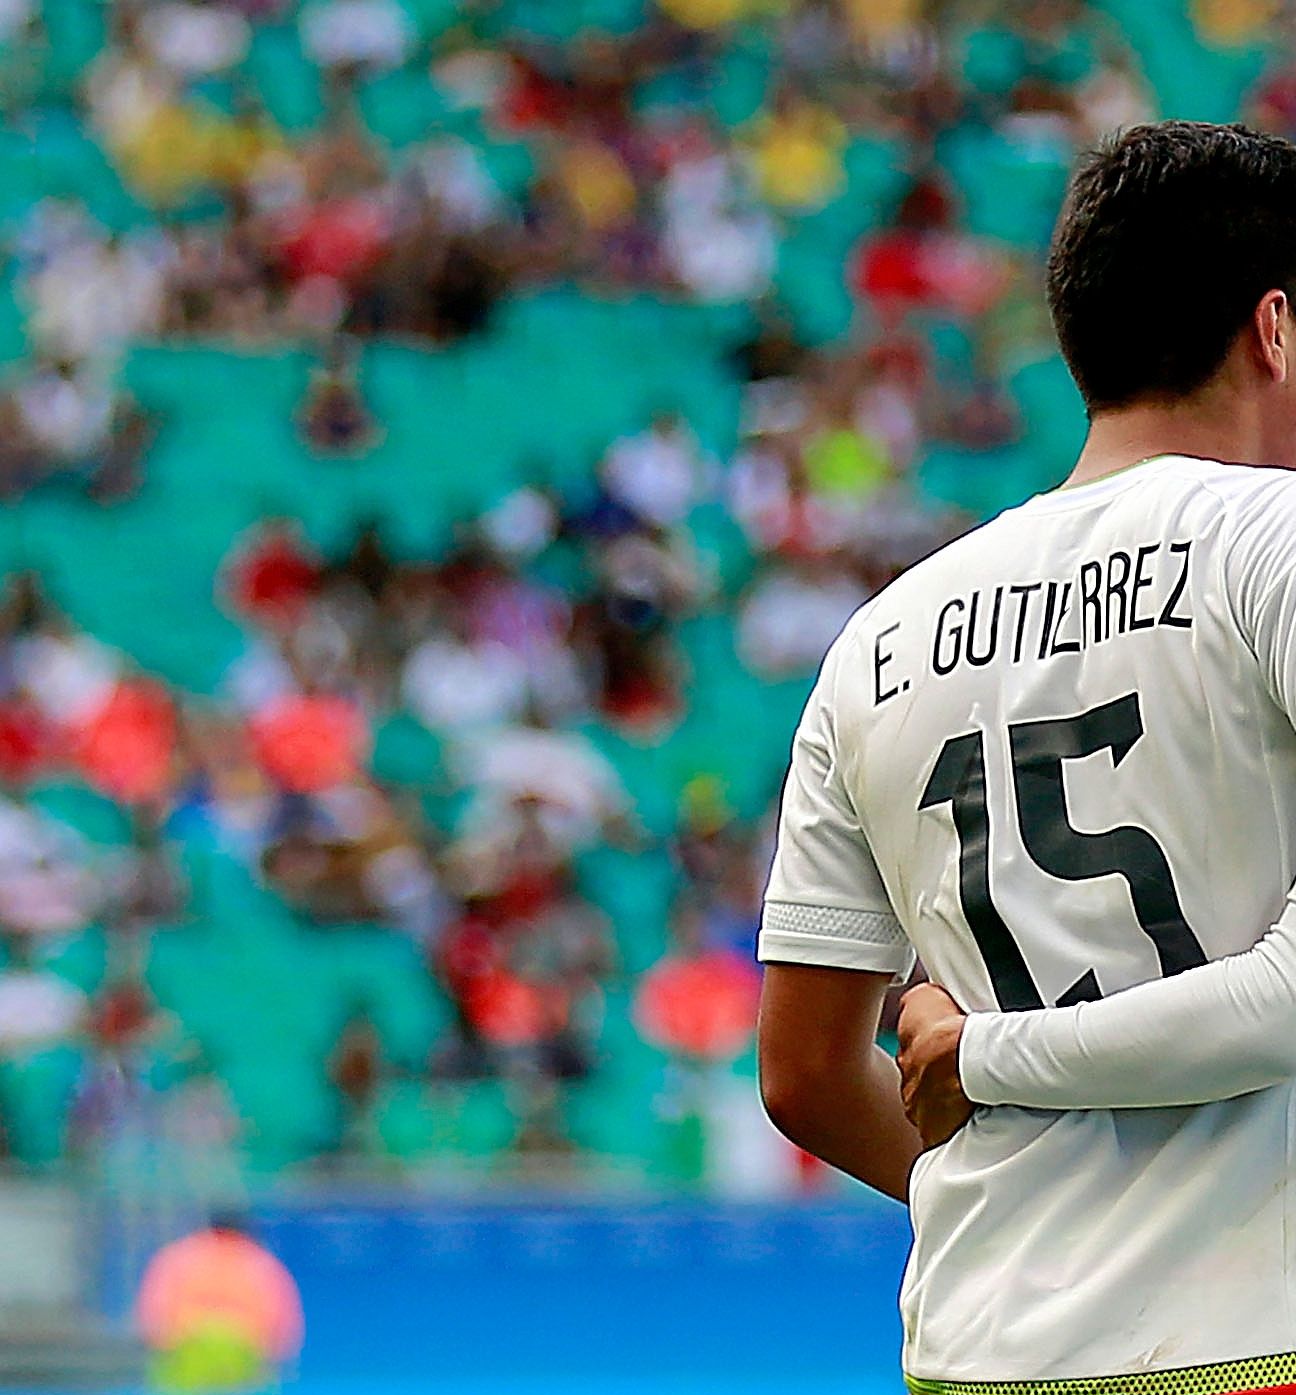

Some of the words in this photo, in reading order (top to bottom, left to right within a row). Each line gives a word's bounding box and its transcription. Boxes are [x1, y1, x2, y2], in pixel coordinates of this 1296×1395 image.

[873, 622, 910, 706] E.
[932, 540, 1194, 677] GUTIERREZ
[917, 691, 1211, 1013] 15
